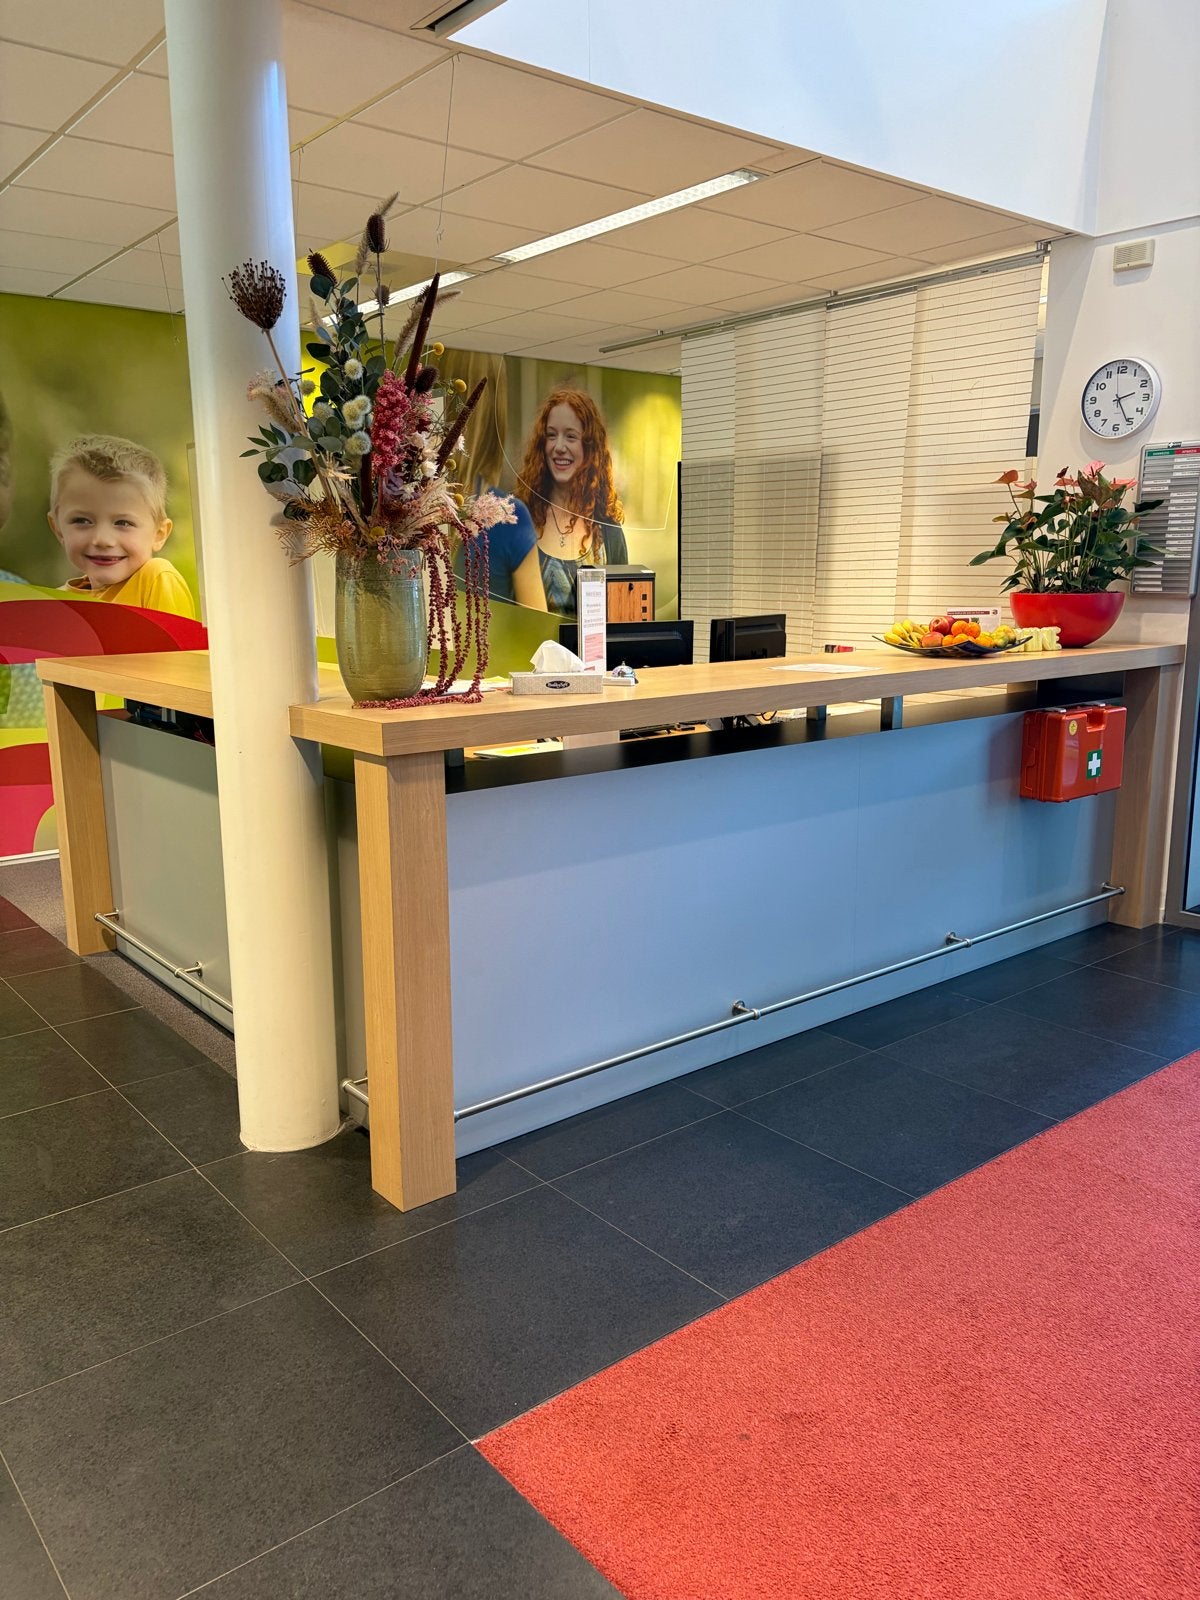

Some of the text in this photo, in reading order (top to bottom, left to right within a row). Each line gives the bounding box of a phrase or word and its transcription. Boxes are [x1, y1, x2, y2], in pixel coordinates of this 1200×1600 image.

[1117, 366, 1128, 374] 12
[1134, 369, 1137, 377] 1
[1106, 371, 1112, 379] 11
[1140, 380, 1148, 388] 2
[1136, 407, 1143, 415] 4
